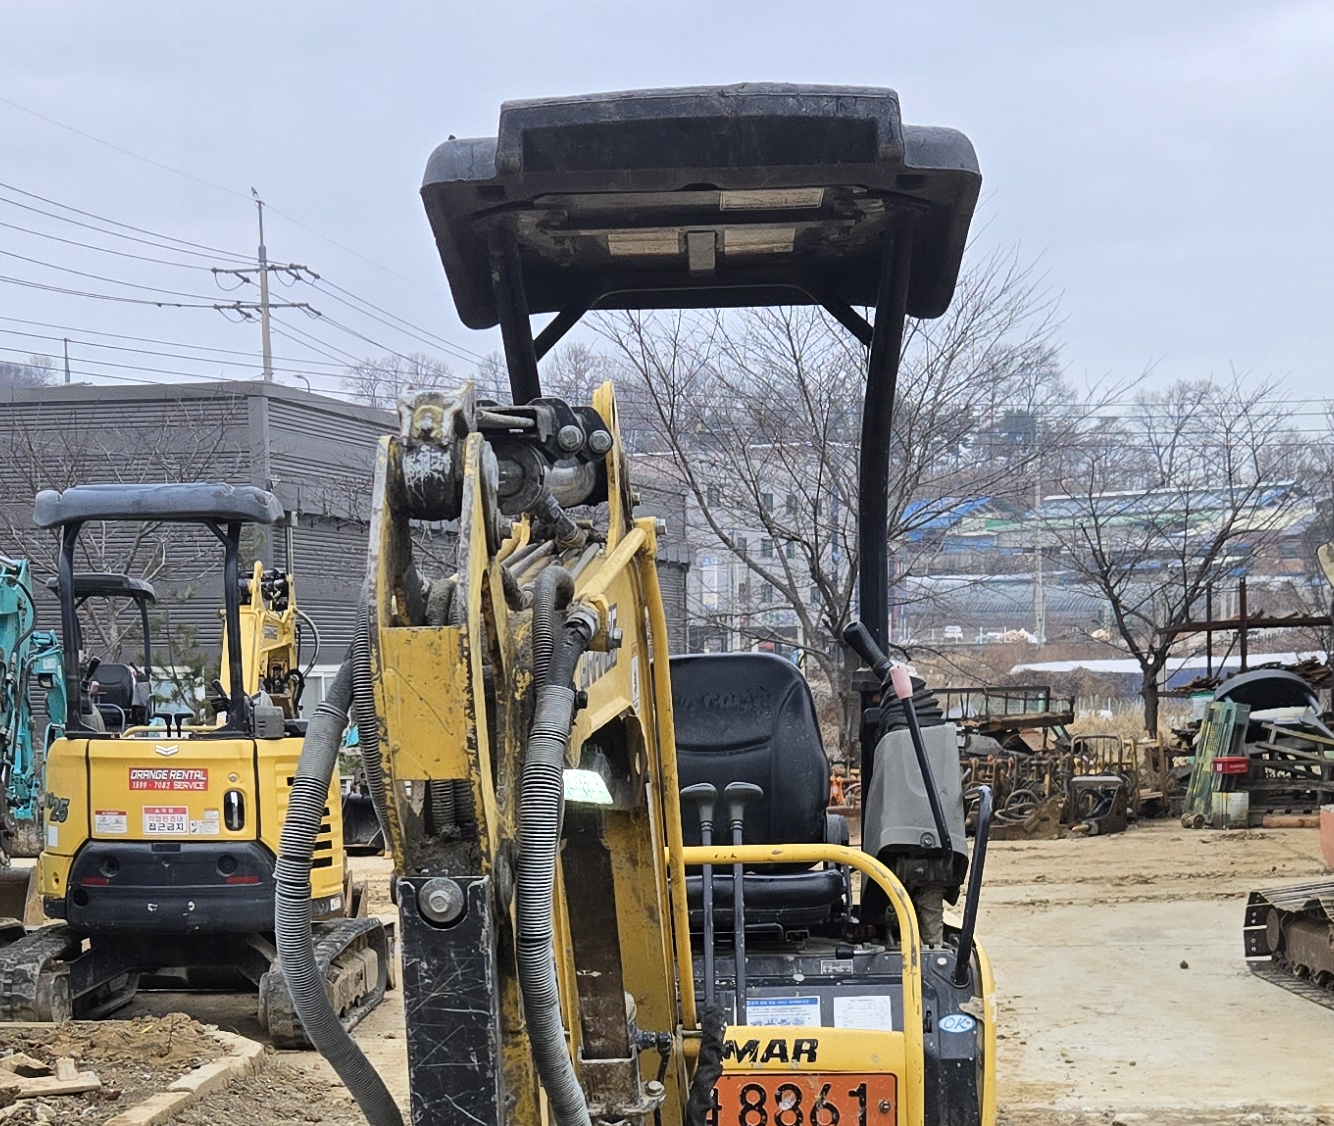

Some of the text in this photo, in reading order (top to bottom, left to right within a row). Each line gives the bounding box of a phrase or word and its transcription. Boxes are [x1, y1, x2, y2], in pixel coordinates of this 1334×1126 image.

[130, 769, 207, 780] ORANGE RENTAL
[173, 781, 205, 790] SERVICE
[148, 822, 184, 831] 접근금지
[944, 1017, 968, 1030] OK
[724, 1038, 819, 1064] MAR
